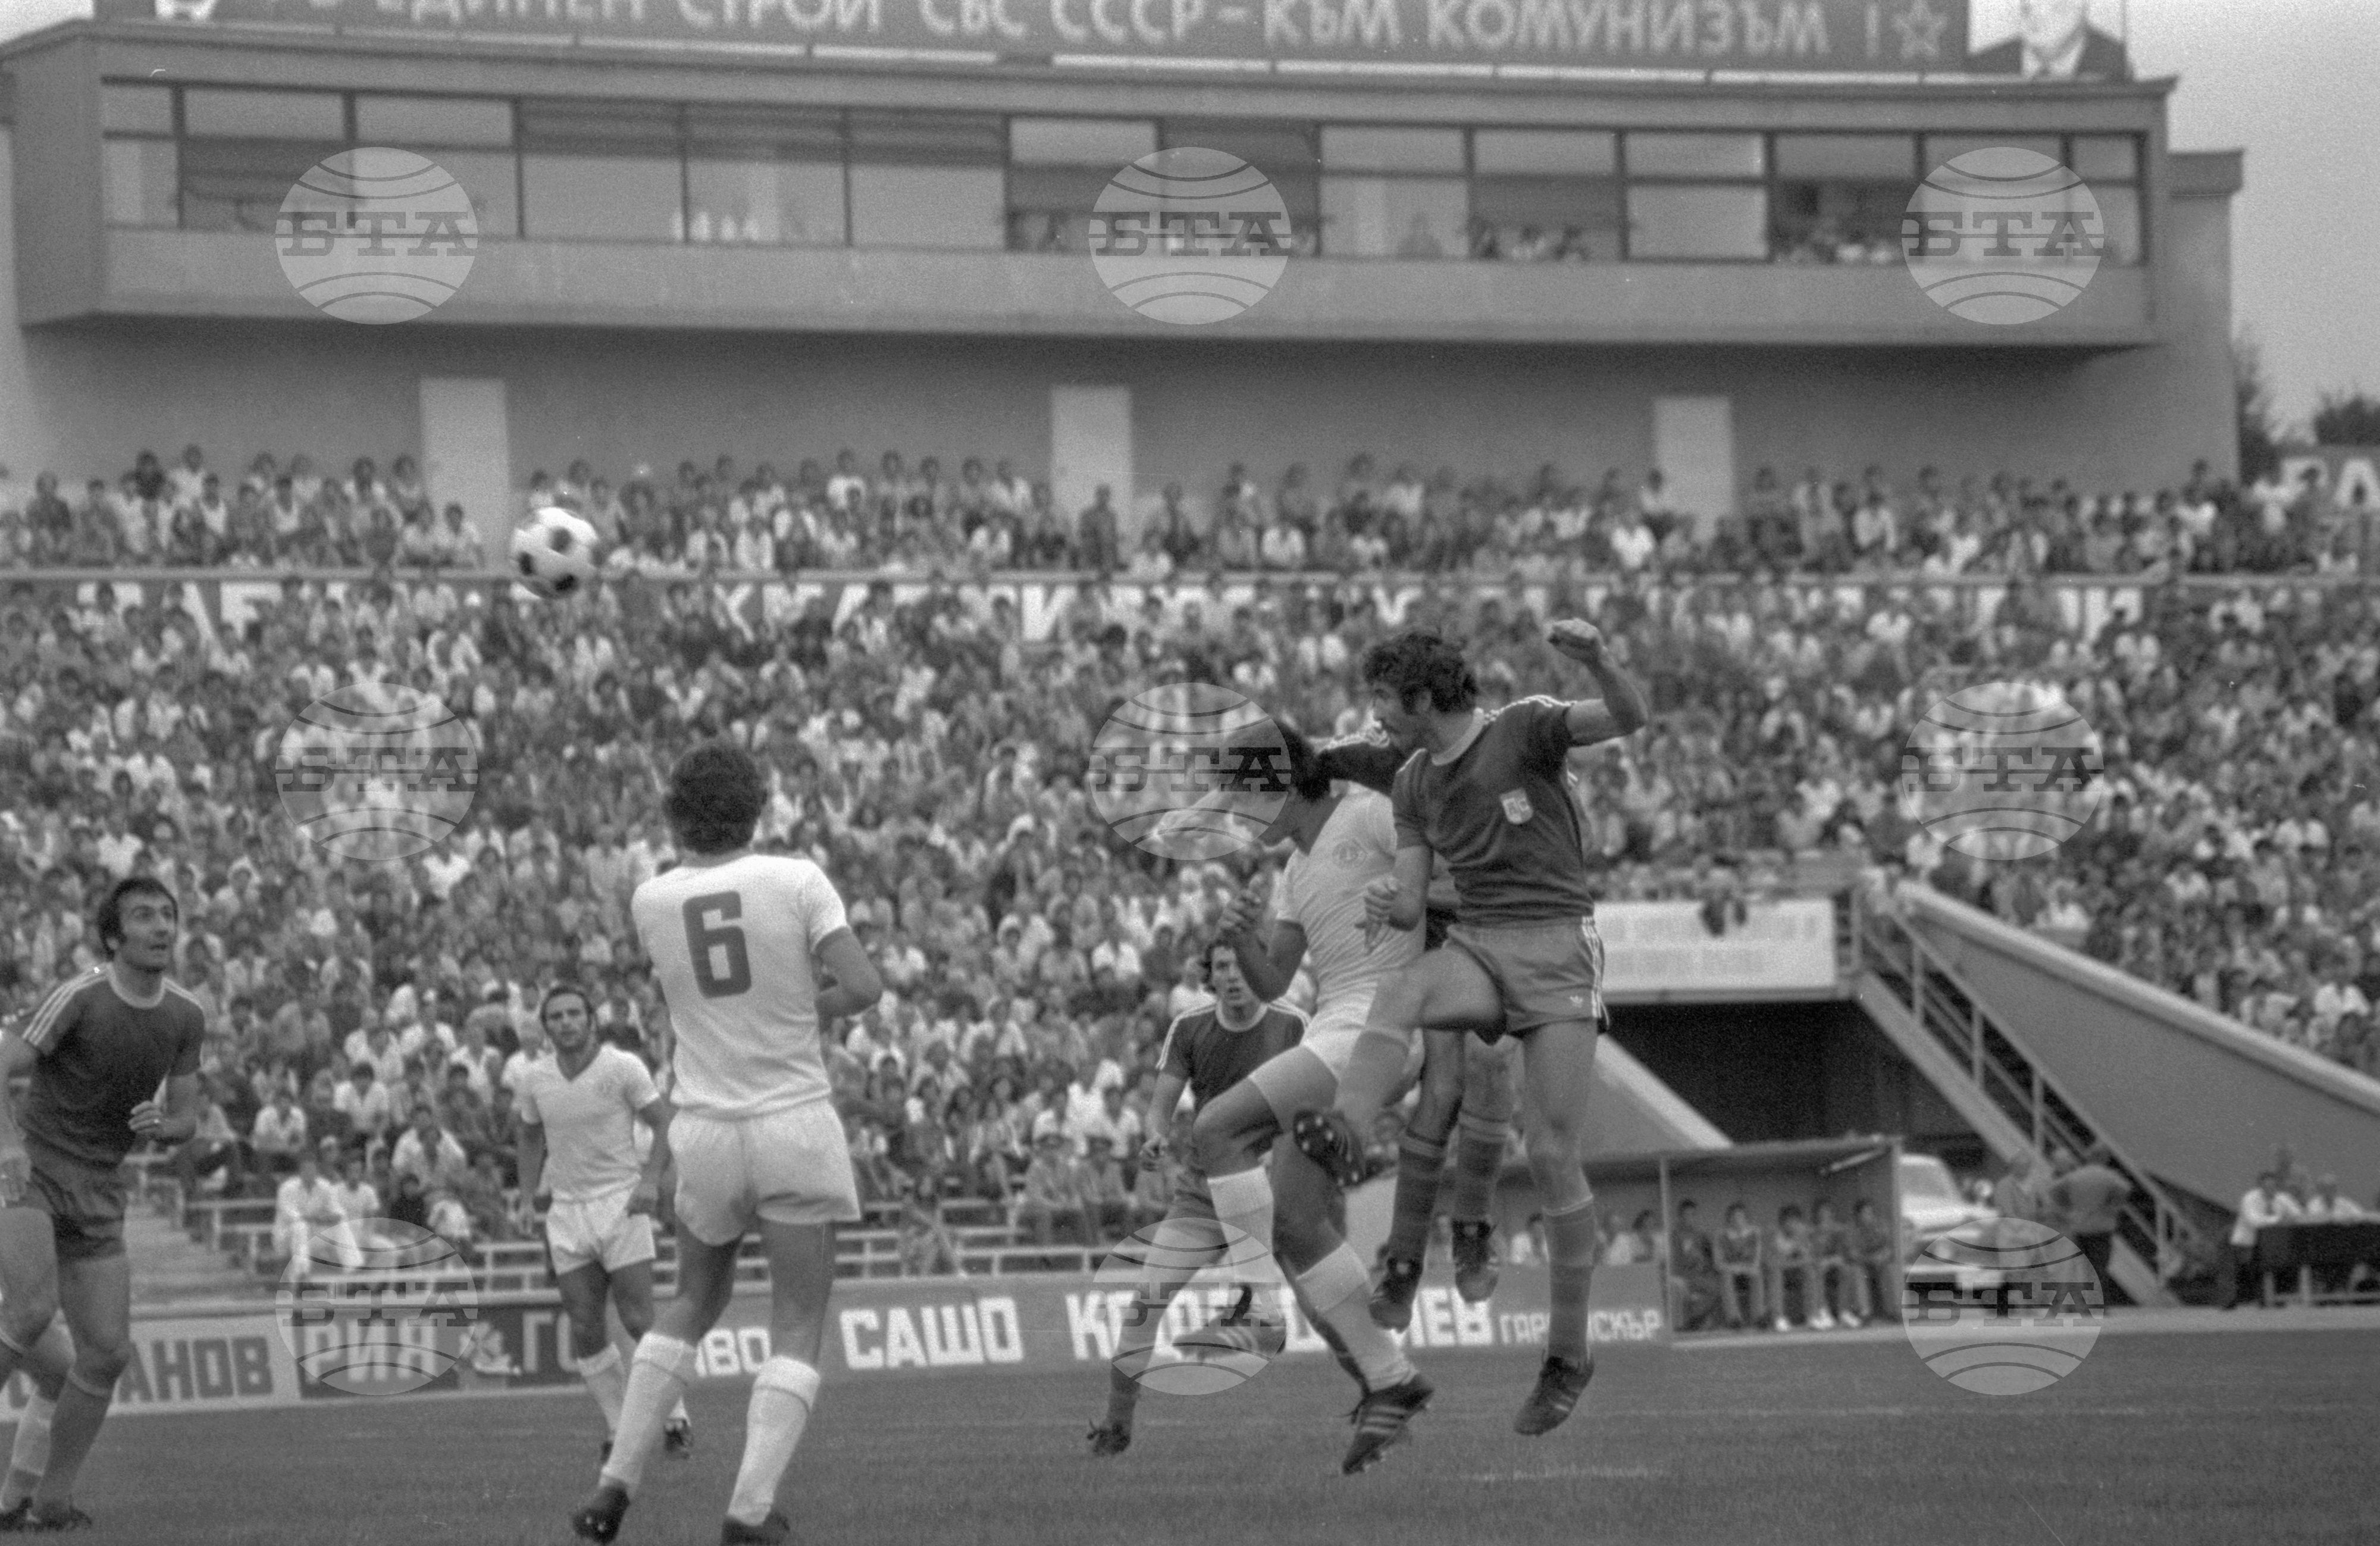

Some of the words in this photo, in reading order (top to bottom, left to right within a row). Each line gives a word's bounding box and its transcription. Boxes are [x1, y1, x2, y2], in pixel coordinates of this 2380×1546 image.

[1427, 0, 1830, 55] КОМУНИЗЪМ
[682, 891, 752, 999] 6
[839, 1296, 1023, 1369] САШО
[118, 1337, 273, 1403] АНОВ
